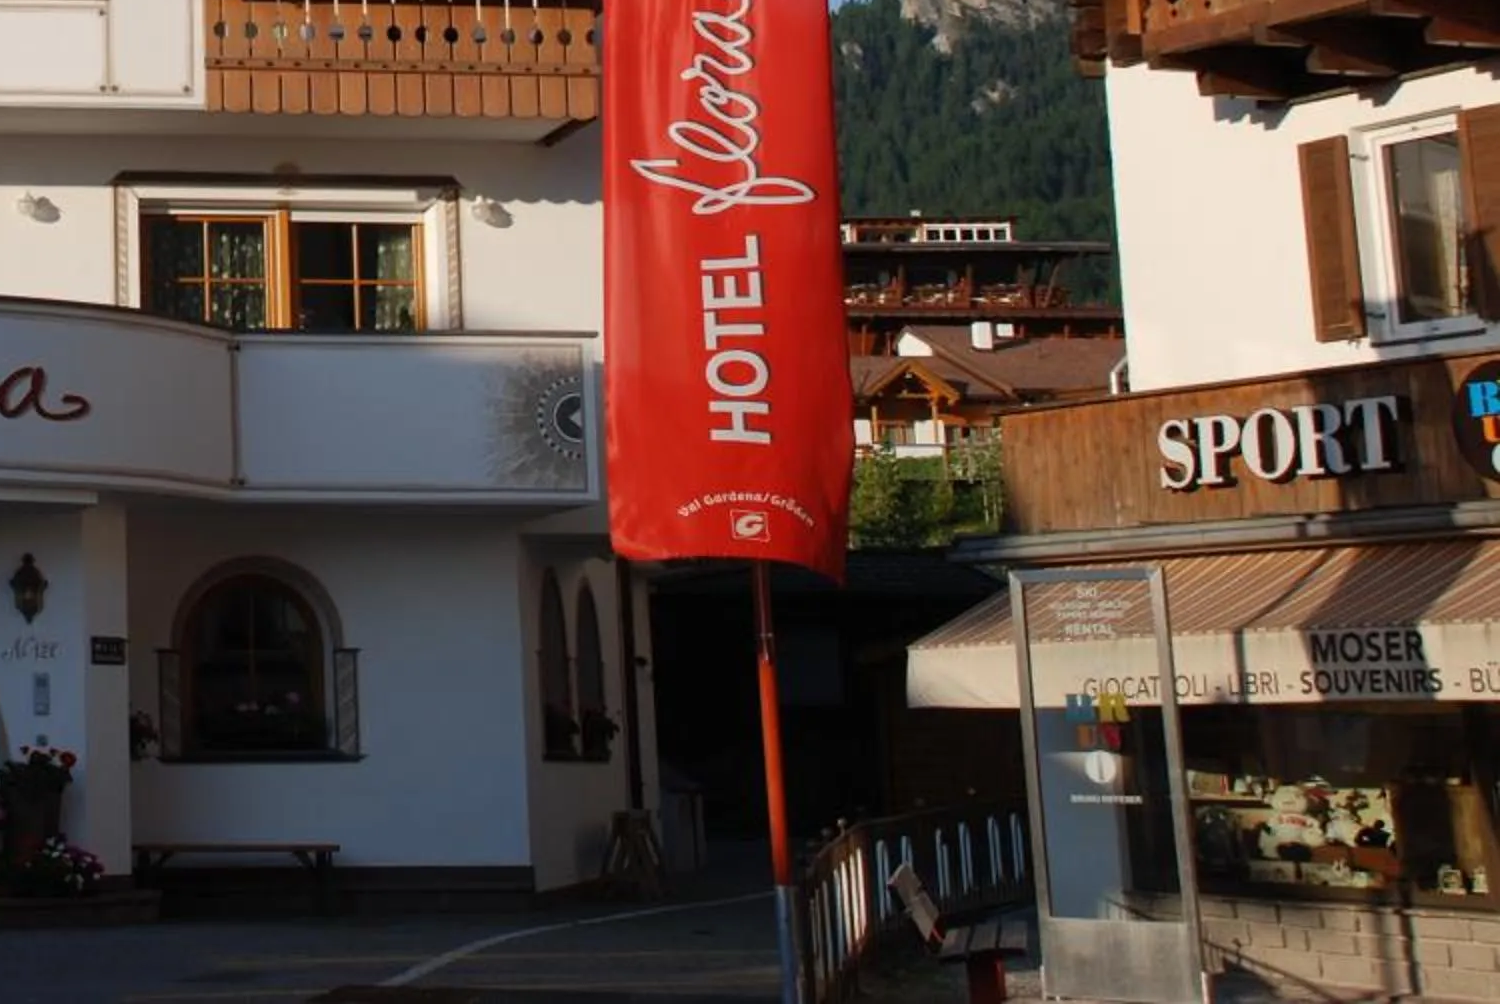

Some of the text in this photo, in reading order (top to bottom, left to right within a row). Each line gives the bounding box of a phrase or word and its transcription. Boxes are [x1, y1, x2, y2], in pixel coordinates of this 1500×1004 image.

[700, 234, 772, 445] HOTEL
[1157, 396, 1398, 489] SPORT
[677, 498, 701, 517] Val
[1309, 630, 1425, 664] MOSER
[1083, 673, 1206, 699] GIOCATOLI
[1227, 671, 1279, 695] LBRI
[1300, 669, 1443, 694] SOUVENIRS
